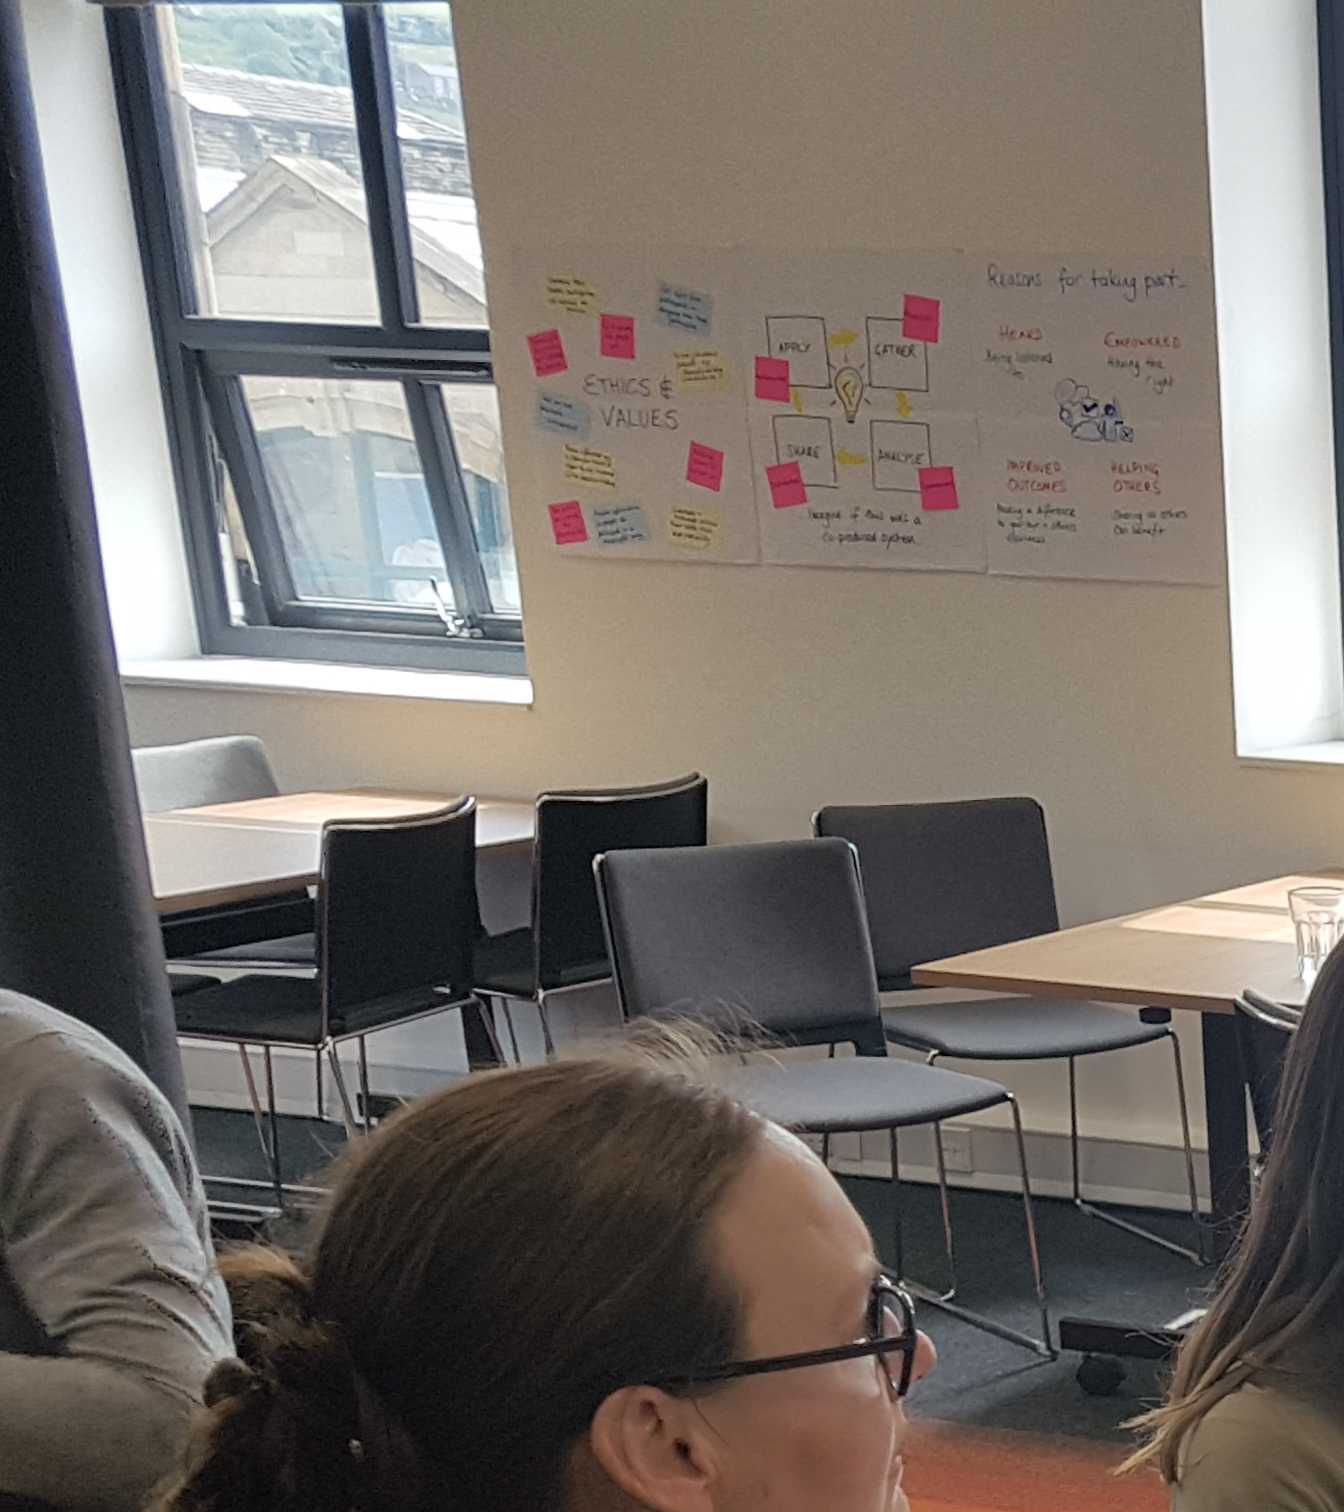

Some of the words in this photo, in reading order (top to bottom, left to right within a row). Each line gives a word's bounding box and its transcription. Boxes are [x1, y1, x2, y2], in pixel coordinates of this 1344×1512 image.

[988, 262, 1042, 288] Reasons
[1059, 268, 1082, 294] for
[1092, 269, 1136, 302] taking
[779, 341, 811, 353] APPLY
[876, 343, 918, 359] GATHER
[583, 374, 650, 398] ETHICS
[600, 405, 679, 430] VALUES
[787, 446, 819, 458] SHARE
[1111, 461, 1160, 475] HELPING
[1008, 478, 1067, 494] OUTCOMES
[1113, 479, 1161, 495] OTHERS
